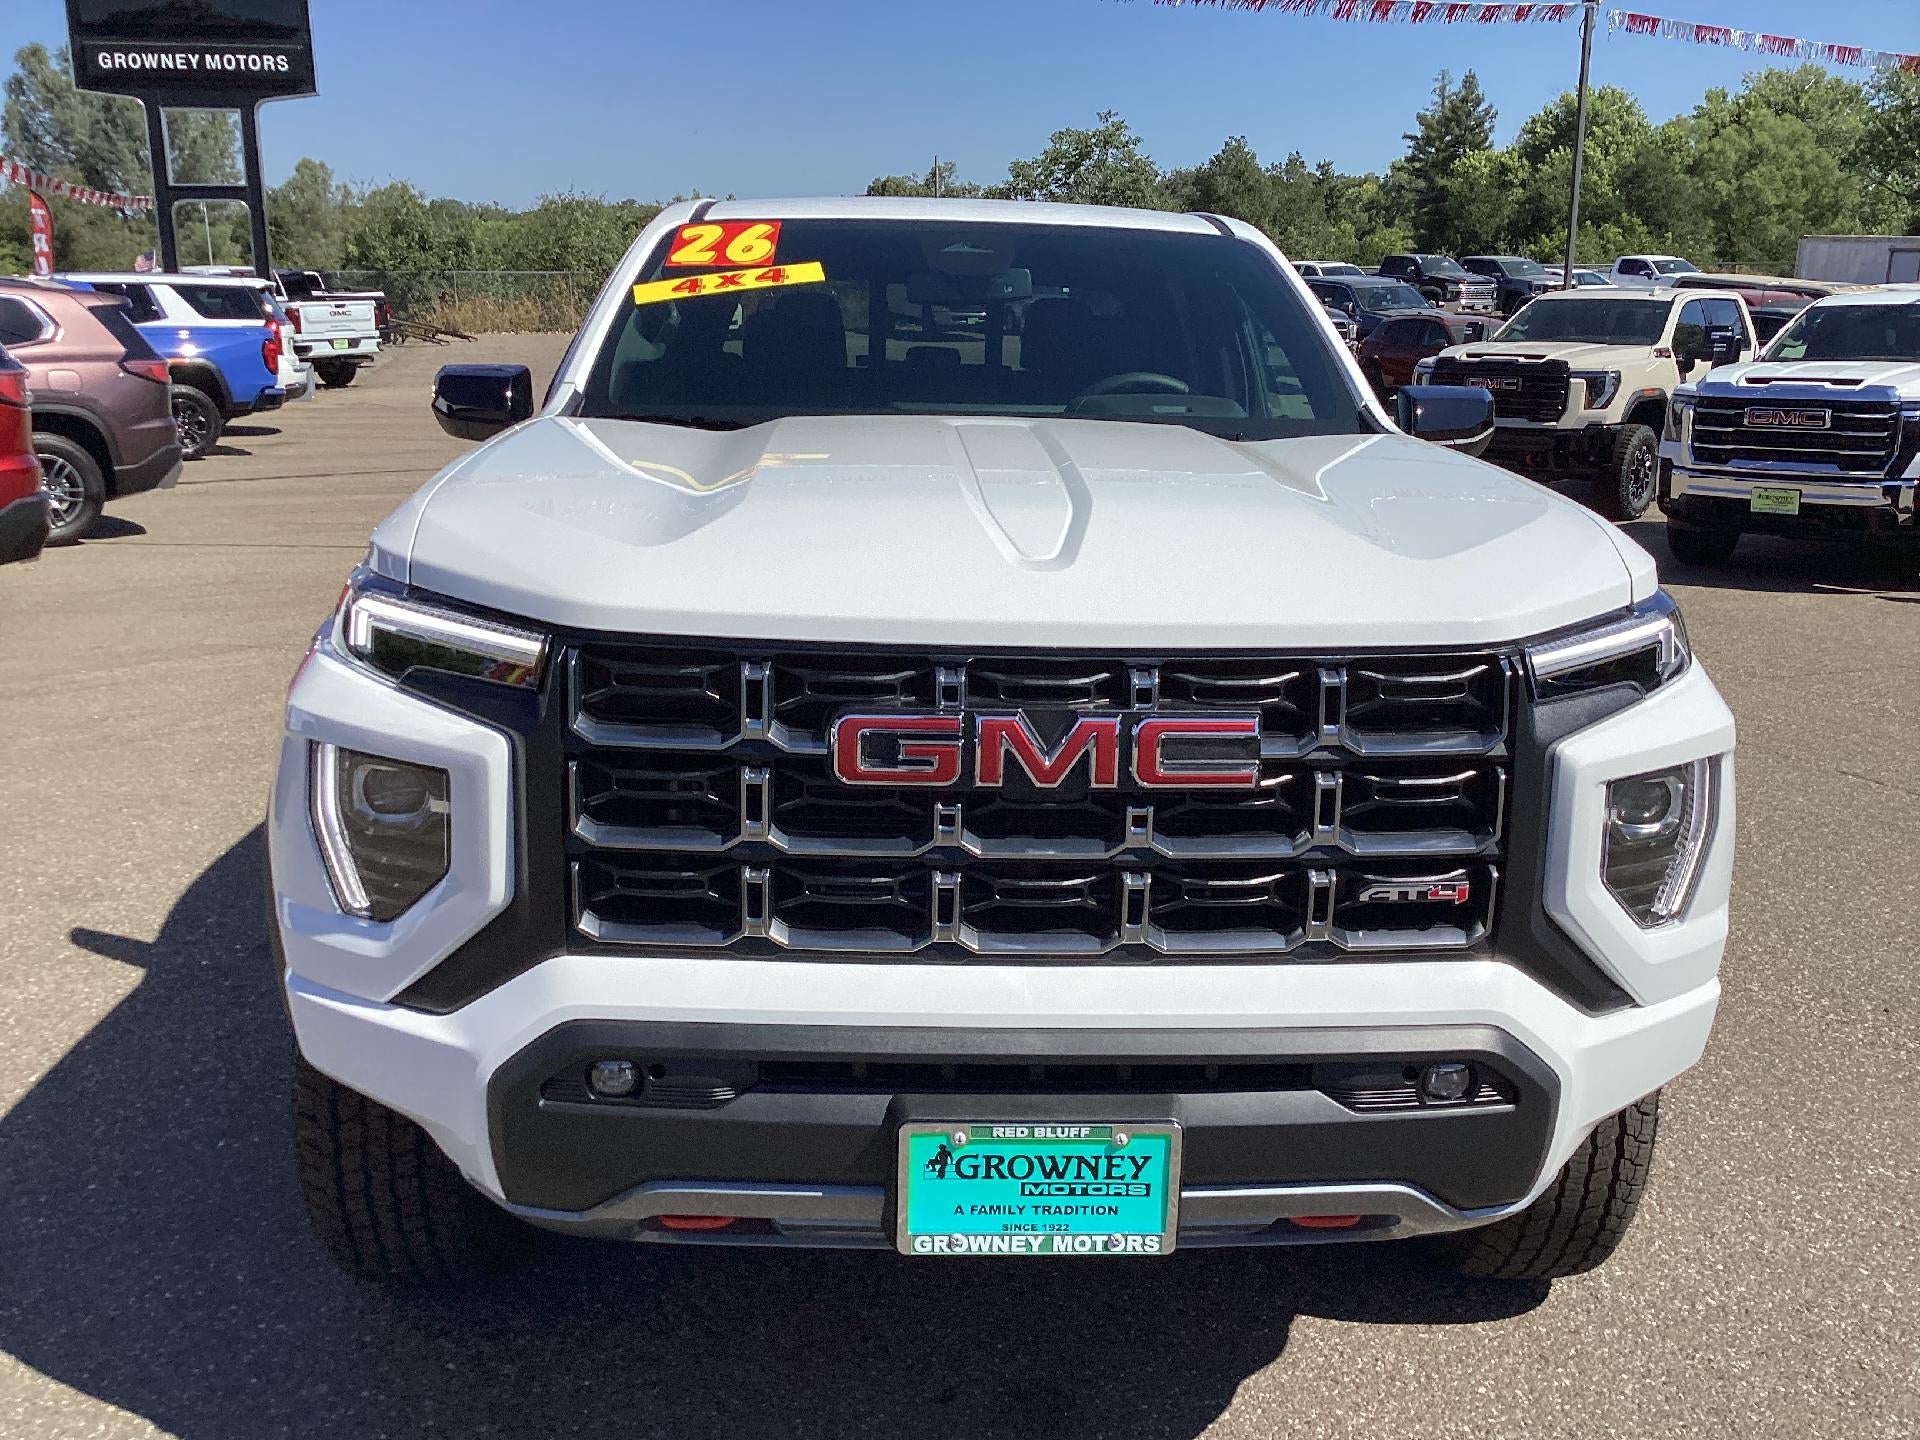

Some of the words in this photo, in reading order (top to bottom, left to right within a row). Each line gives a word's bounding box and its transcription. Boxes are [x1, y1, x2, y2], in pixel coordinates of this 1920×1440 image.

[98, 52, 200, 70] GROWNEY
[205, 54, 289, 72] MOTORS
[671, 224, 777, 265] 26
[1749, 410, 1825, 426] GMC
[832, 713, 1260, 788] GMC
[1360, 881, 1469, 905] AT4
[992, 1126, 1029, 1138] RED
[1034, 1126, 1090, 1138] BLUFF
[954, 1154, 1153, 1181] GROWNEY
[1023, 1184, 1147, 1196] MOTORS
[953, 1205, 964, 1216] A
[970, 1205, 1026, 1216] FAMILY
[1033, 1205, 1119, 1216] TRADITION
[1001, 1223, 1038, 1232] SINCE
[1042, 1223, 1070, 1232] 1922
[914, 1235, 1046, 1252] GROWNEY
[1052, 1235, 1160, 1252] MOTORS
